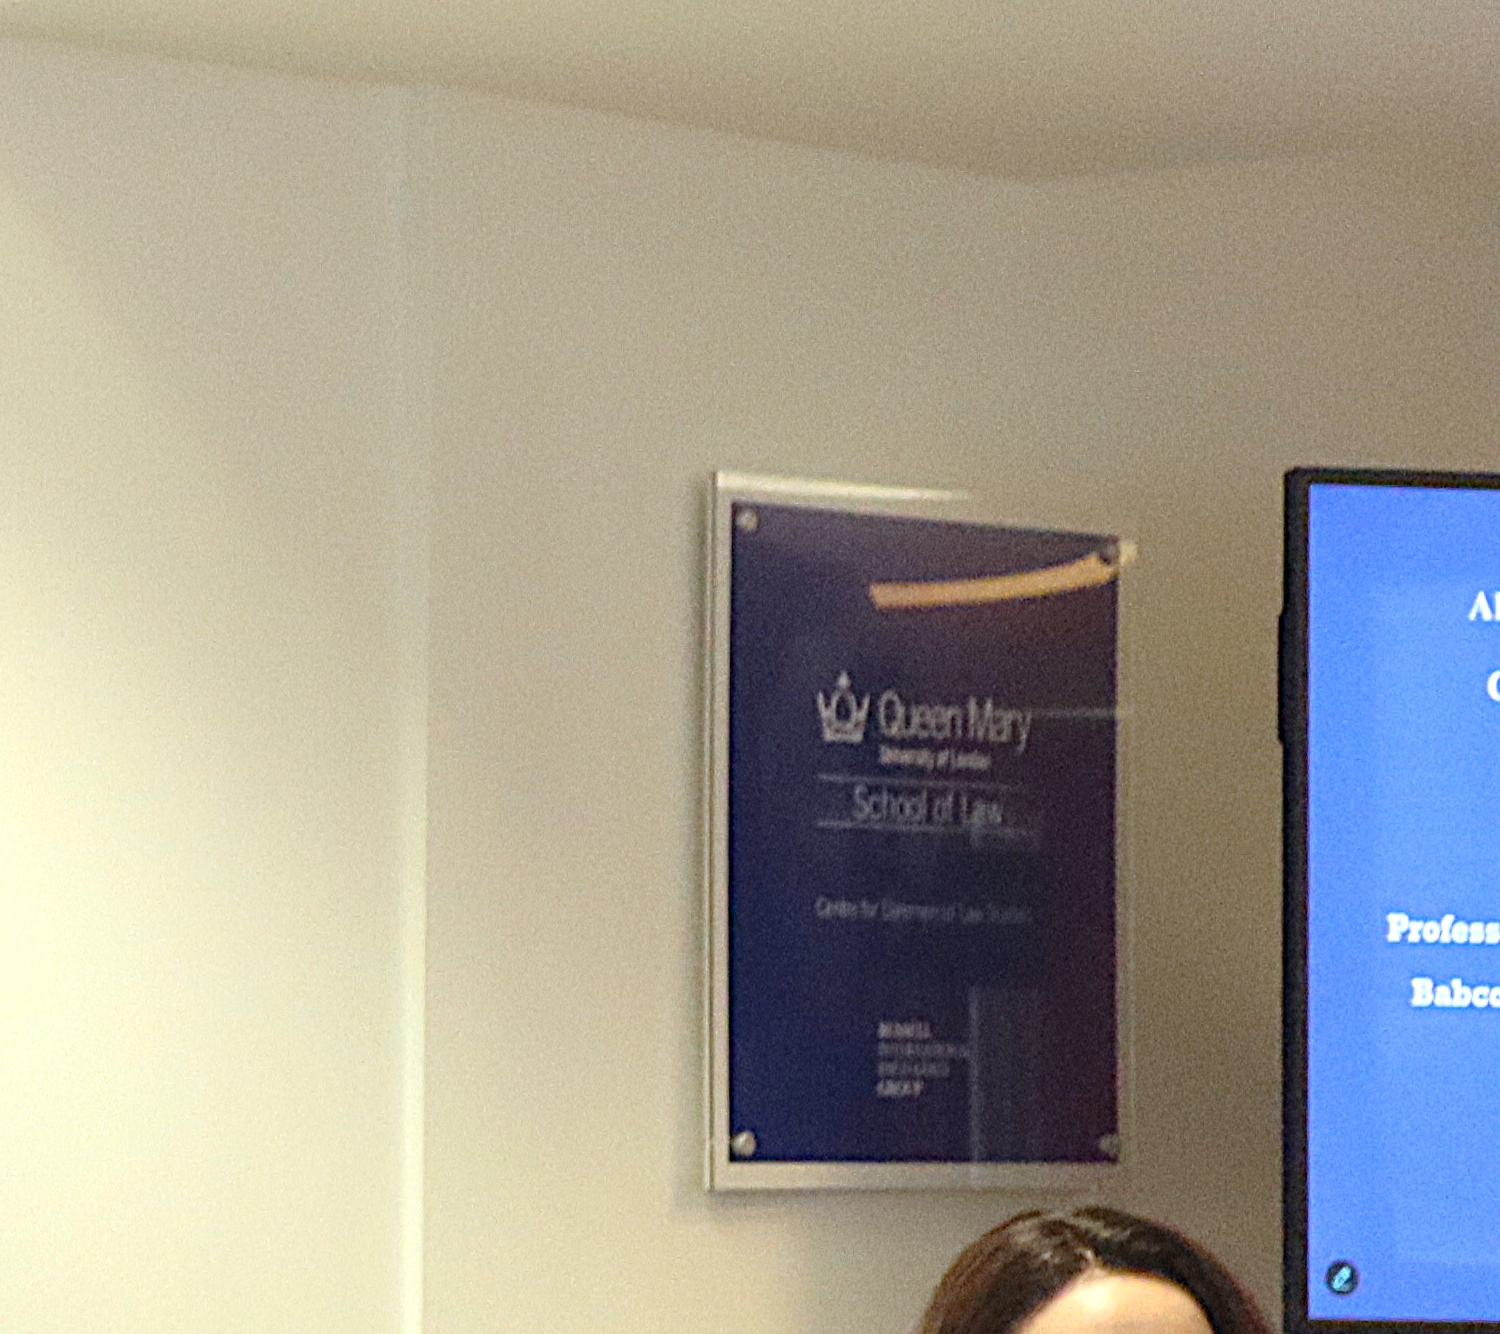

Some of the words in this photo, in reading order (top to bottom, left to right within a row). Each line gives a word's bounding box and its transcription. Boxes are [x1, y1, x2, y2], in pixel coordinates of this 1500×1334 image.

[877, 689, 964, 740] Queen
[968, 694, 1032, 755] Mary
[853, 784, 928, 821] School
[933, 790, 954, 821] of
[1386, 912, 1500, 944] Profess
[1410, 977, 1500, 1008] Babco
